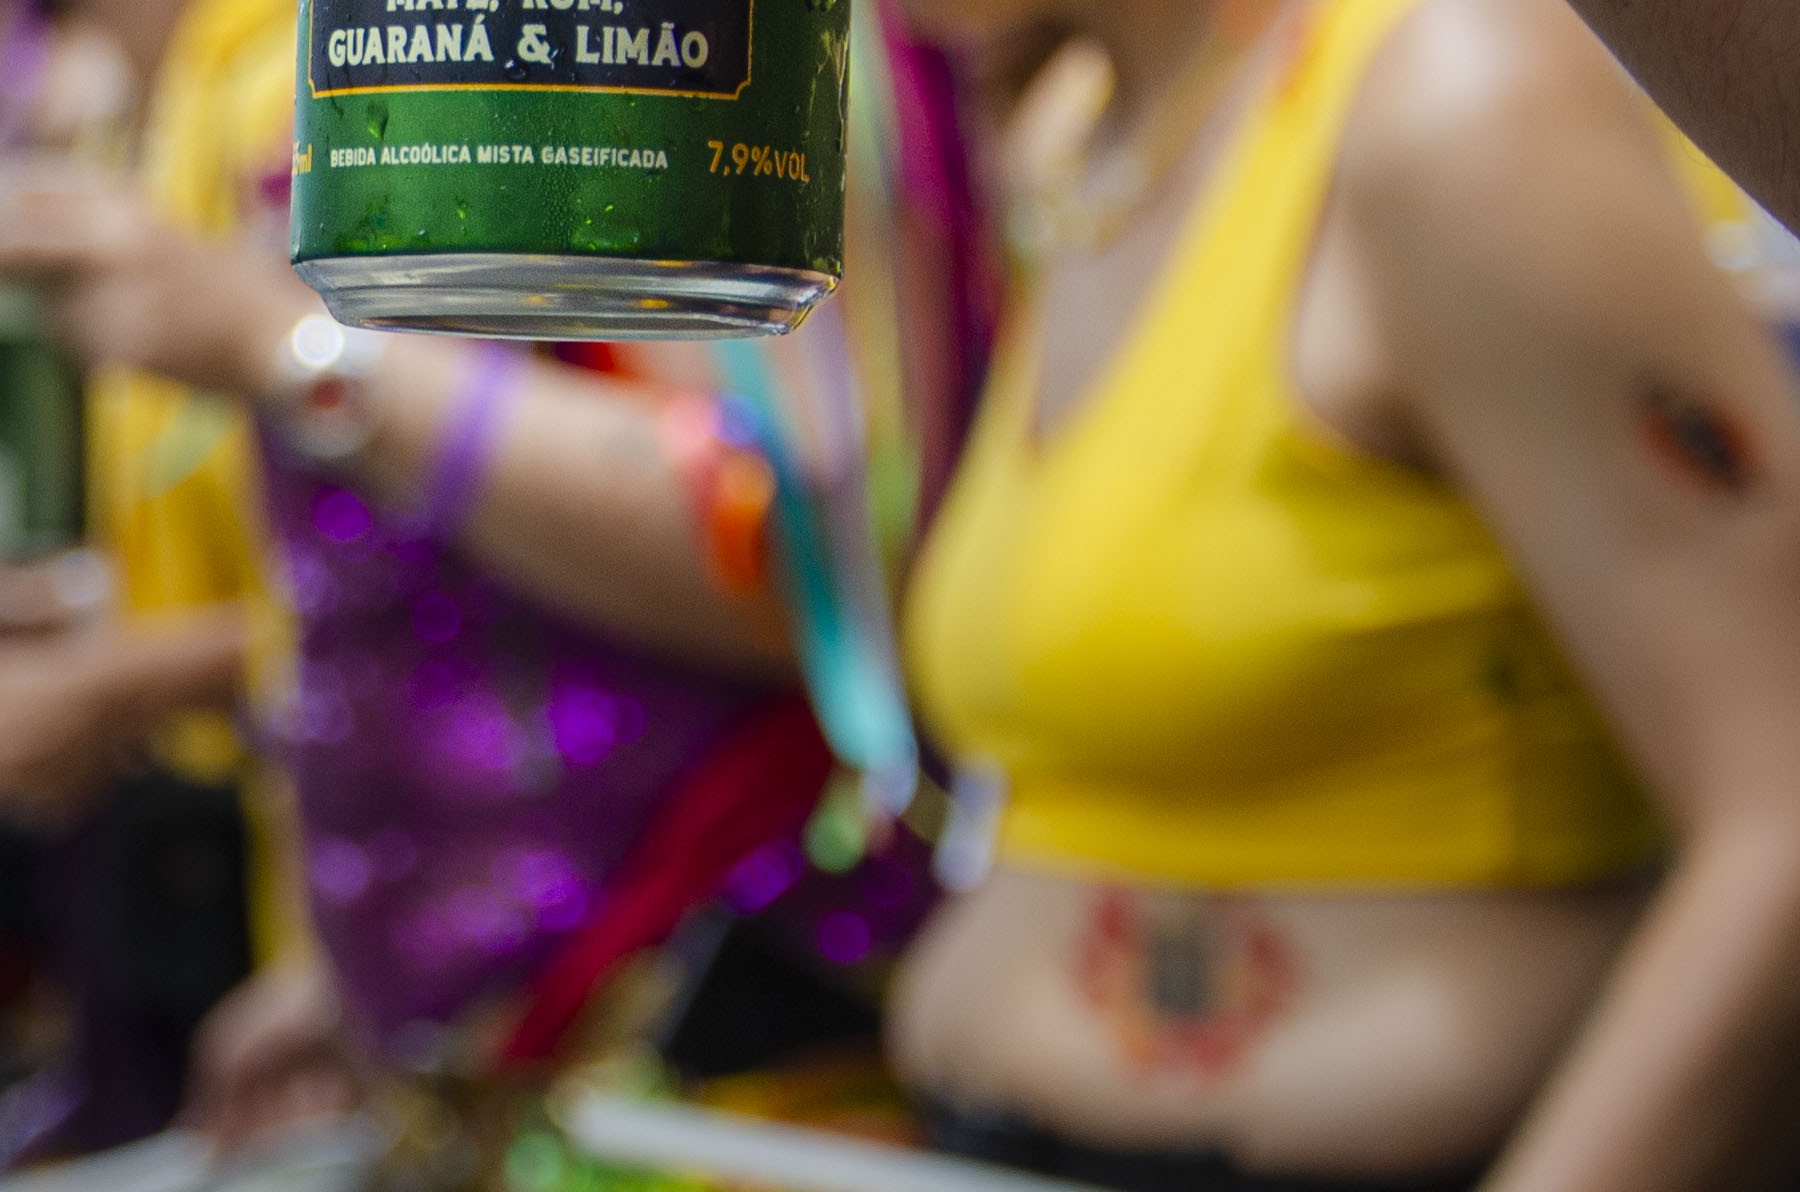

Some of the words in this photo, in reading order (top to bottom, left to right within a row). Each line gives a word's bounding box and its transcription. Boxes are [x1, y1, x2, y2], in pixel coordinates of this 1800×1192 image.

[328, 14, 494, 67] GUARANÁ
[517, 24, 552, 65] &
[575, 22, 709, 68] LIMÃO
[330, 149, 376, 167] BEBIDA
[381, 143, 471, 164] ALCOÓLICA
[477, 145, 534, 164] MISTA
[541, 146, 668, 169] GASEIFICADA
